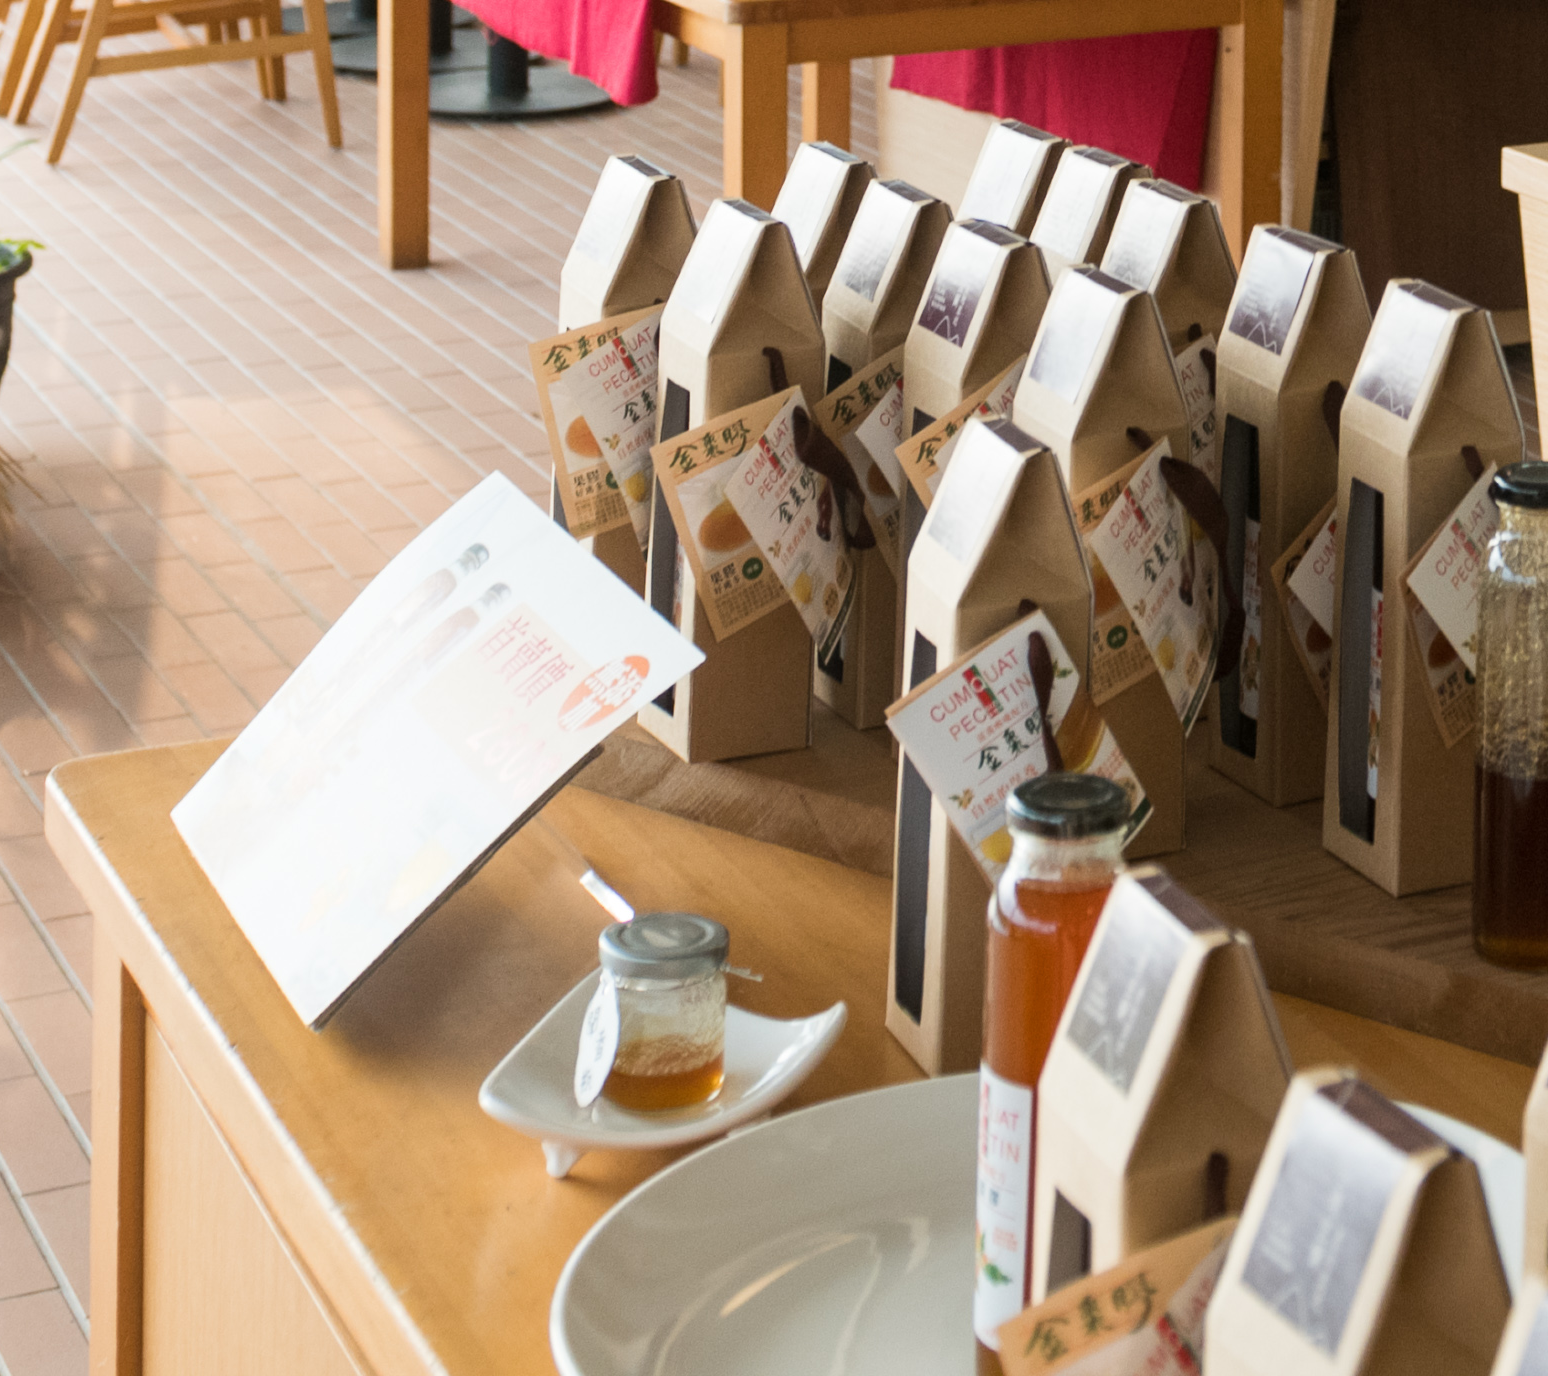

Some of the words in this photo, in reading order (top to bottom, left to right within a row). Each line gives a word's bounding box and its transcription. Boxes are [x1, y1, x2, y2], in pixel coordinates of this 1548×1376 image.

[668, 418, 751, 474] 金棗膠
[475, 615, 576, 708] 首賣價
[929, 648, 1021, 724] CUMQUAT
